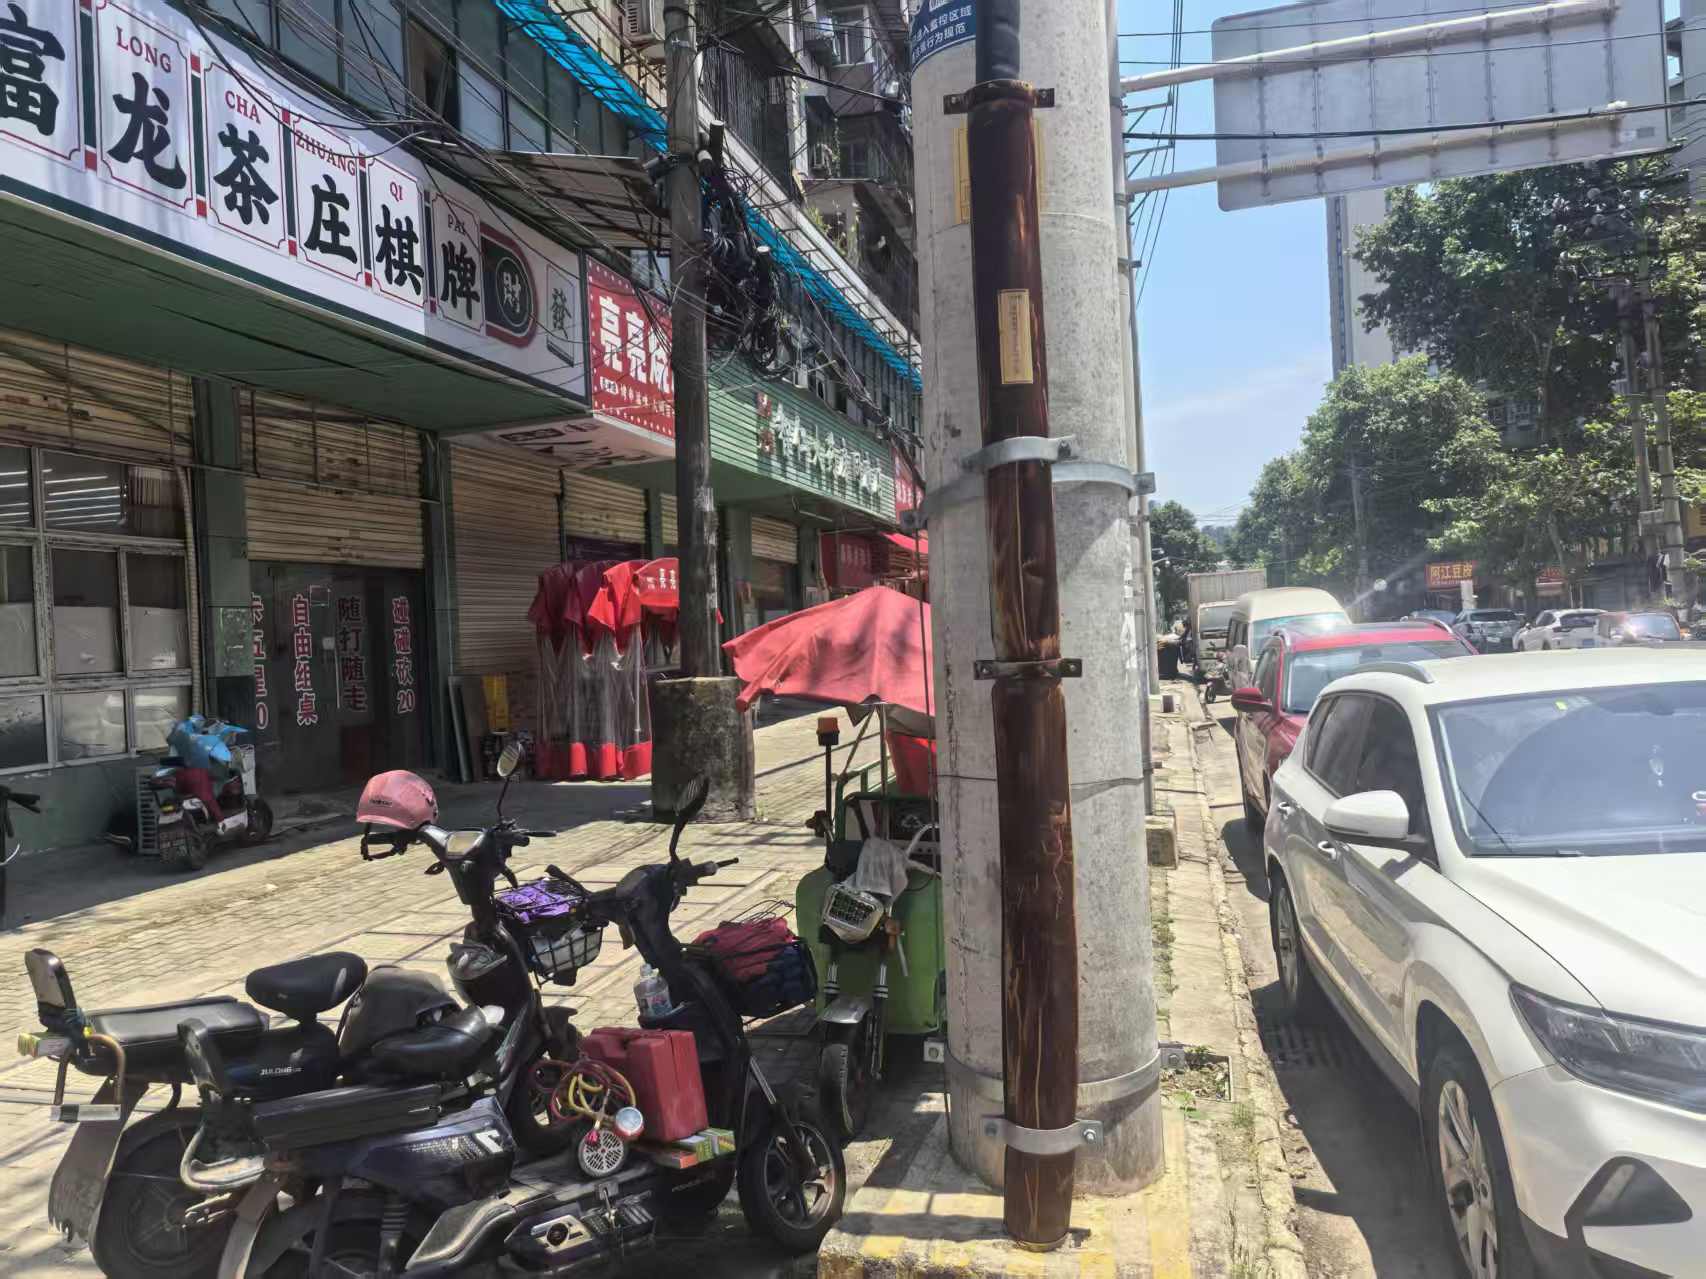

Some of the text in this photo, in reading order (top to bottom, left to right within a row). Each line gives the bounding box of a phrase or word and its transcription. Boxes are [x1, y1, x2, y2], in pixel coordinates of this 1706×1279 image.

[116, 26, 466, 236] LONG CHA ZHUANG QI PAI
[292, 593, 318, 727] 自由组桌
[337, 596, 368, 713] 随打随走
